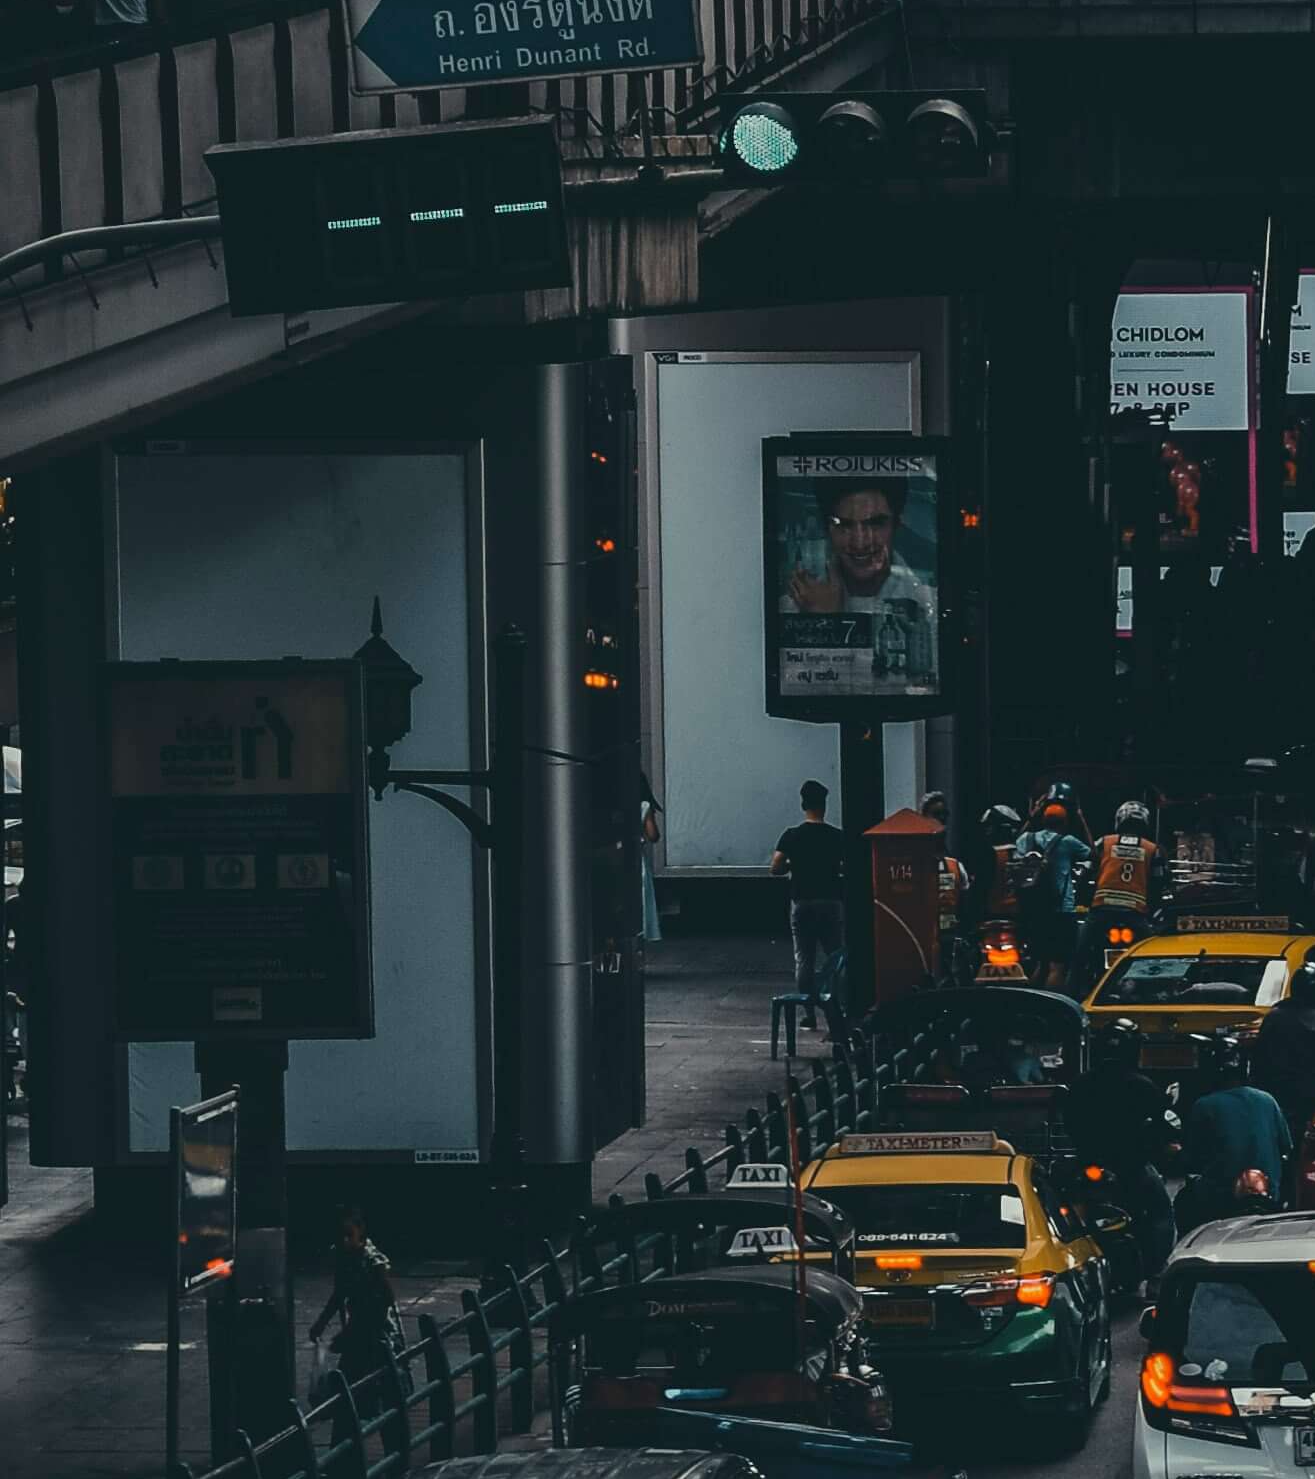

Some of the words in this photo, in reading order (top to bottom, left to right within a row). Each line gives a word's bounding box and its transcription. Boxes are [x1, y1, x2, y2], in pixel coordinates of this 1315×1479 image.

[438, 49, 502, 74] Henri
[515, 42, 602, 68] Dunant
[617, 37, 657, 59] Rd.
[1116, 327, 1205, 342] CHIDLOM
[1147, 382, 1216, 396] HOUSE
[815, 456, 923, 472] ROJUKISS
[1120, 863, 1135, 882] 8
[865, 1134, 965, 1152] TAXI-METER
[739, 1167, 781, 1183] TAXI
[740, 1232, 785, 1246] TAXI
